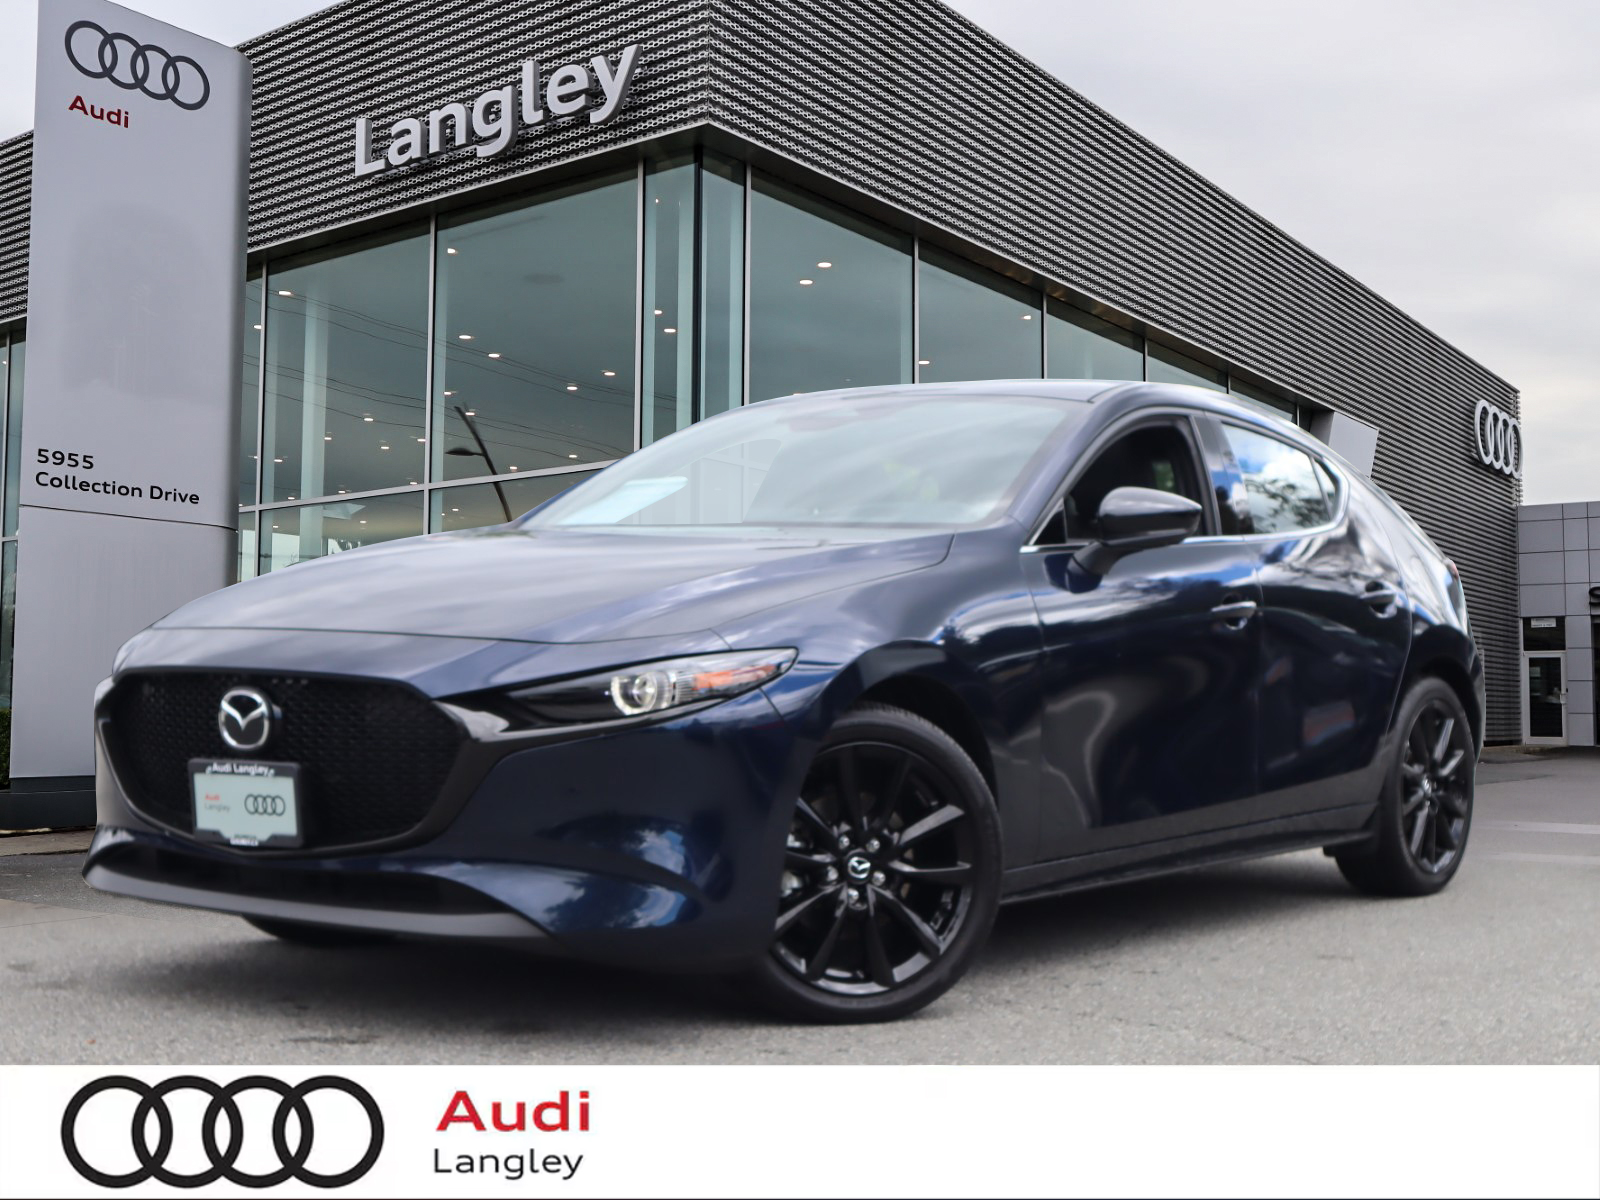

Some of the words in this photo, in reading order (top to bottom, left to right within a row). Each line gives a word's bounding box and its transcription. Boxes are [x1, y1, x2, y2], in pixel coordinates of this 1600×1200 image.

[69, 95, 129, 128] Audi
[355, 44, 643, 177] Langley
[37, 448, 94, 469] 5955
[35, 472, 142, 498] Collection
[150, 485, 200, 504] Drive
[212, 763, 232, 773] Audi
[233, 763, 269, 777] Langley
[204, 793, 221, 801] Audi
